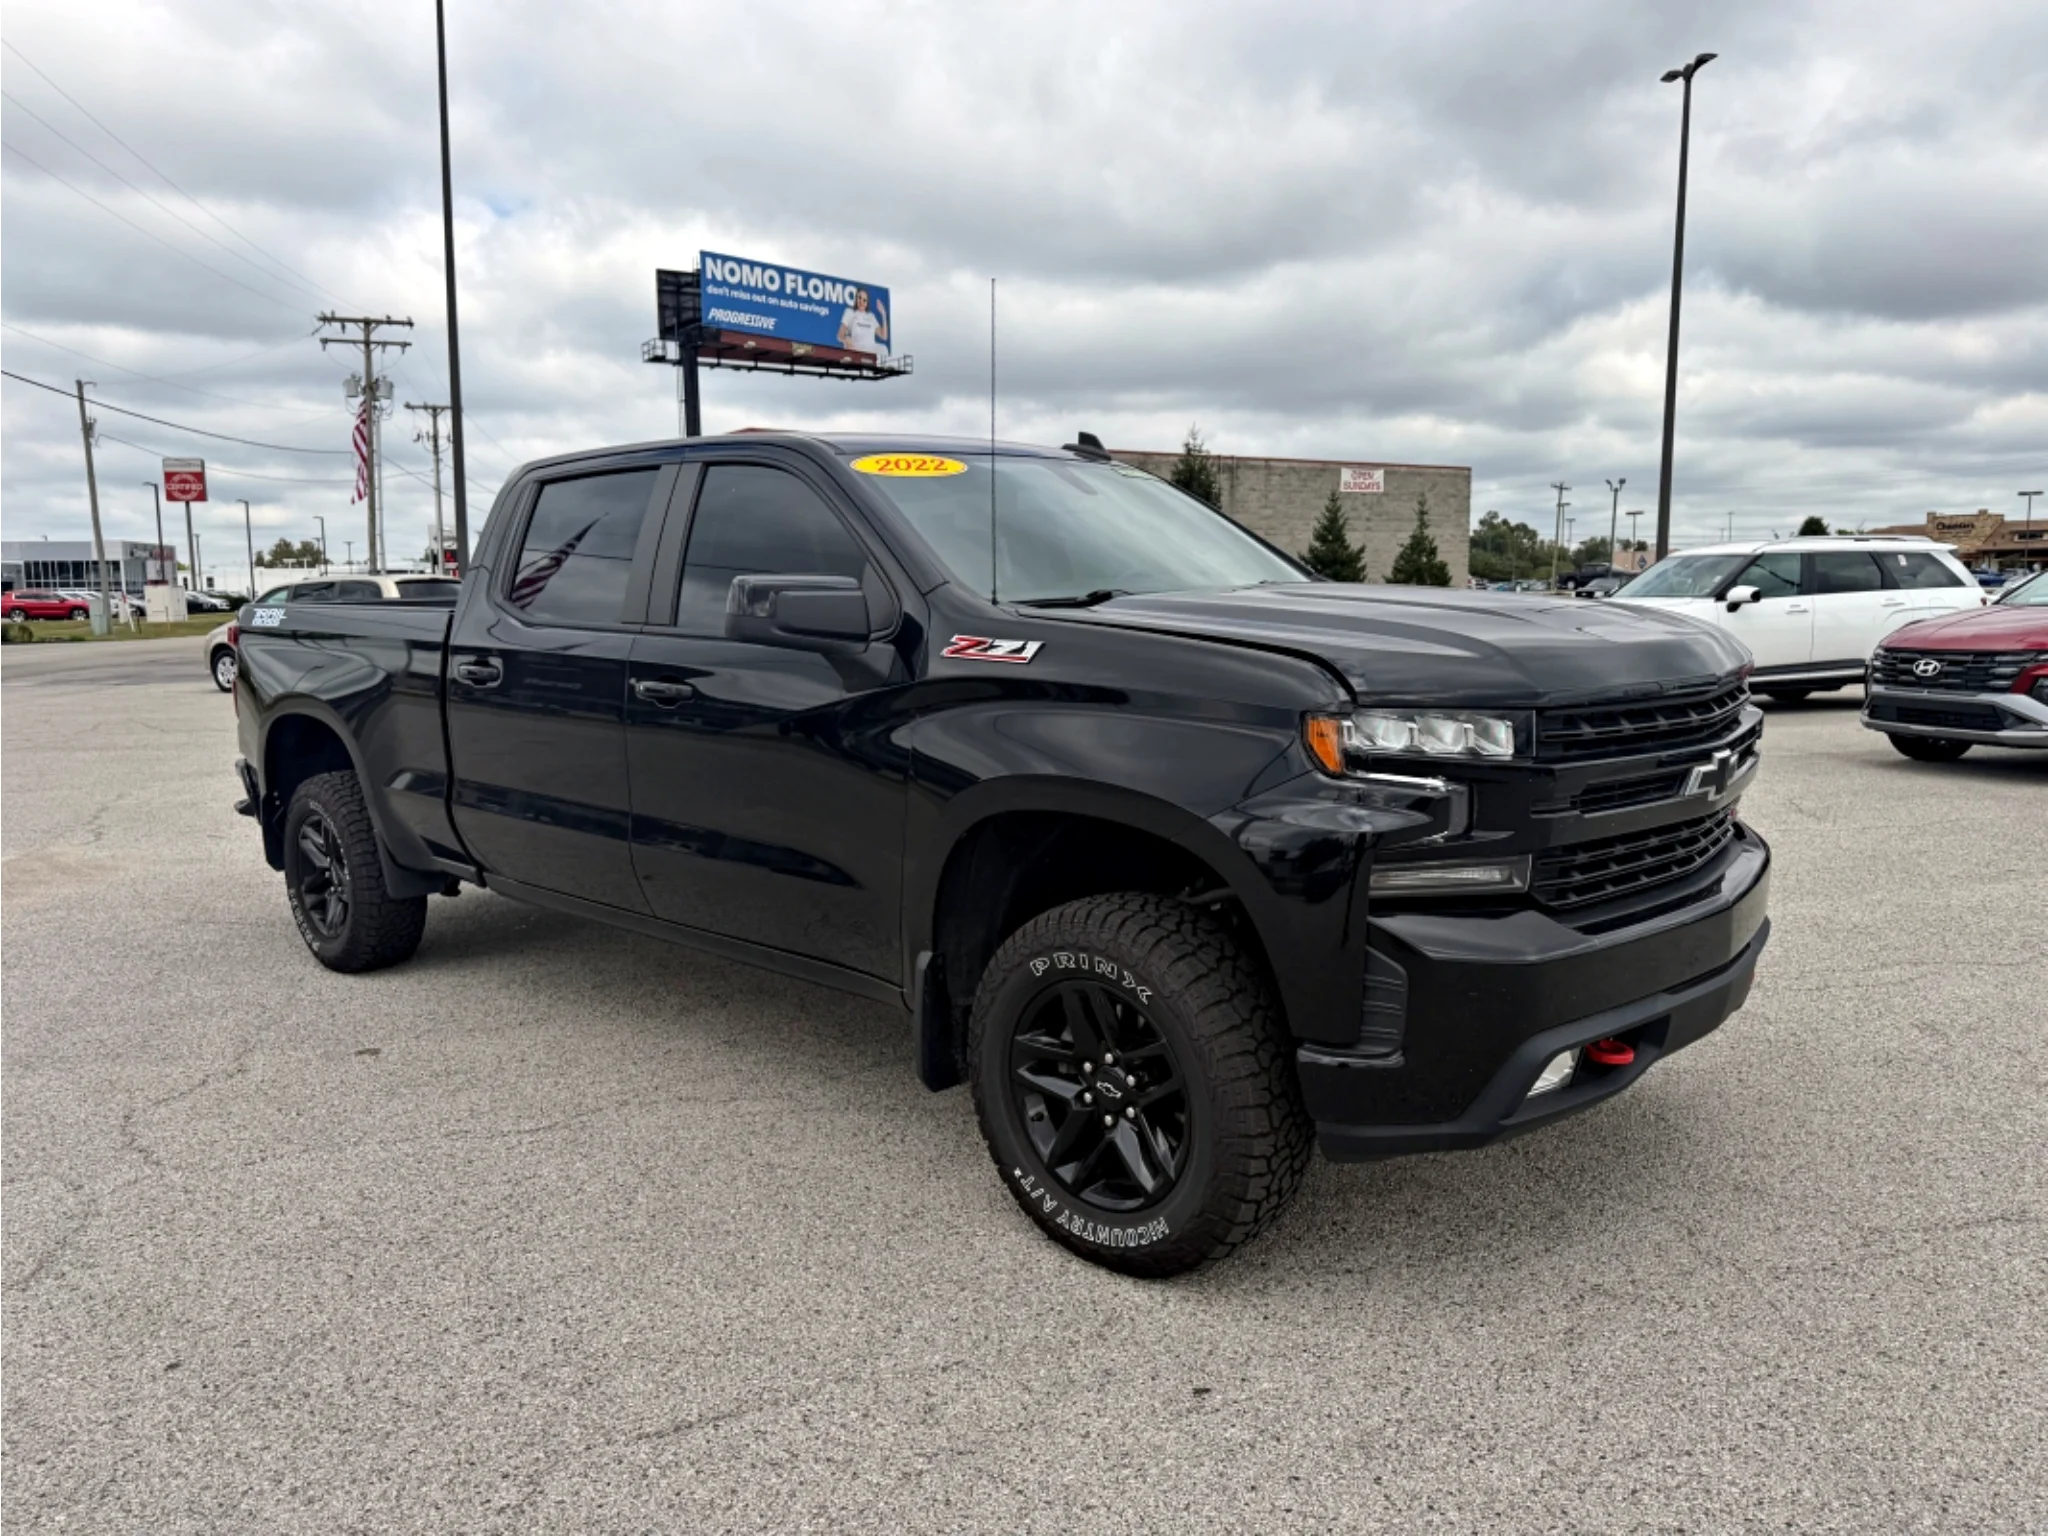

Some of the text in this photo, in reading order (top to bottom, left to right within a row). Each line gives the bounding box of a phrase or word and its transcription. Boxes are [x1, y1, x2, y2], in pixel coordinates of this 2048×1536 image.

[705, 256, 857, 306] NOMO FLOMO
[706, 284, 829, 316] don't miss out on auto savings
[708, 307, 777, 331] PROGRESSIVE
[876, 458, 948, 472] 2022
[941, 634, 1045, 664] Z71
[1030, 952, 1153, 1005] PRINX
